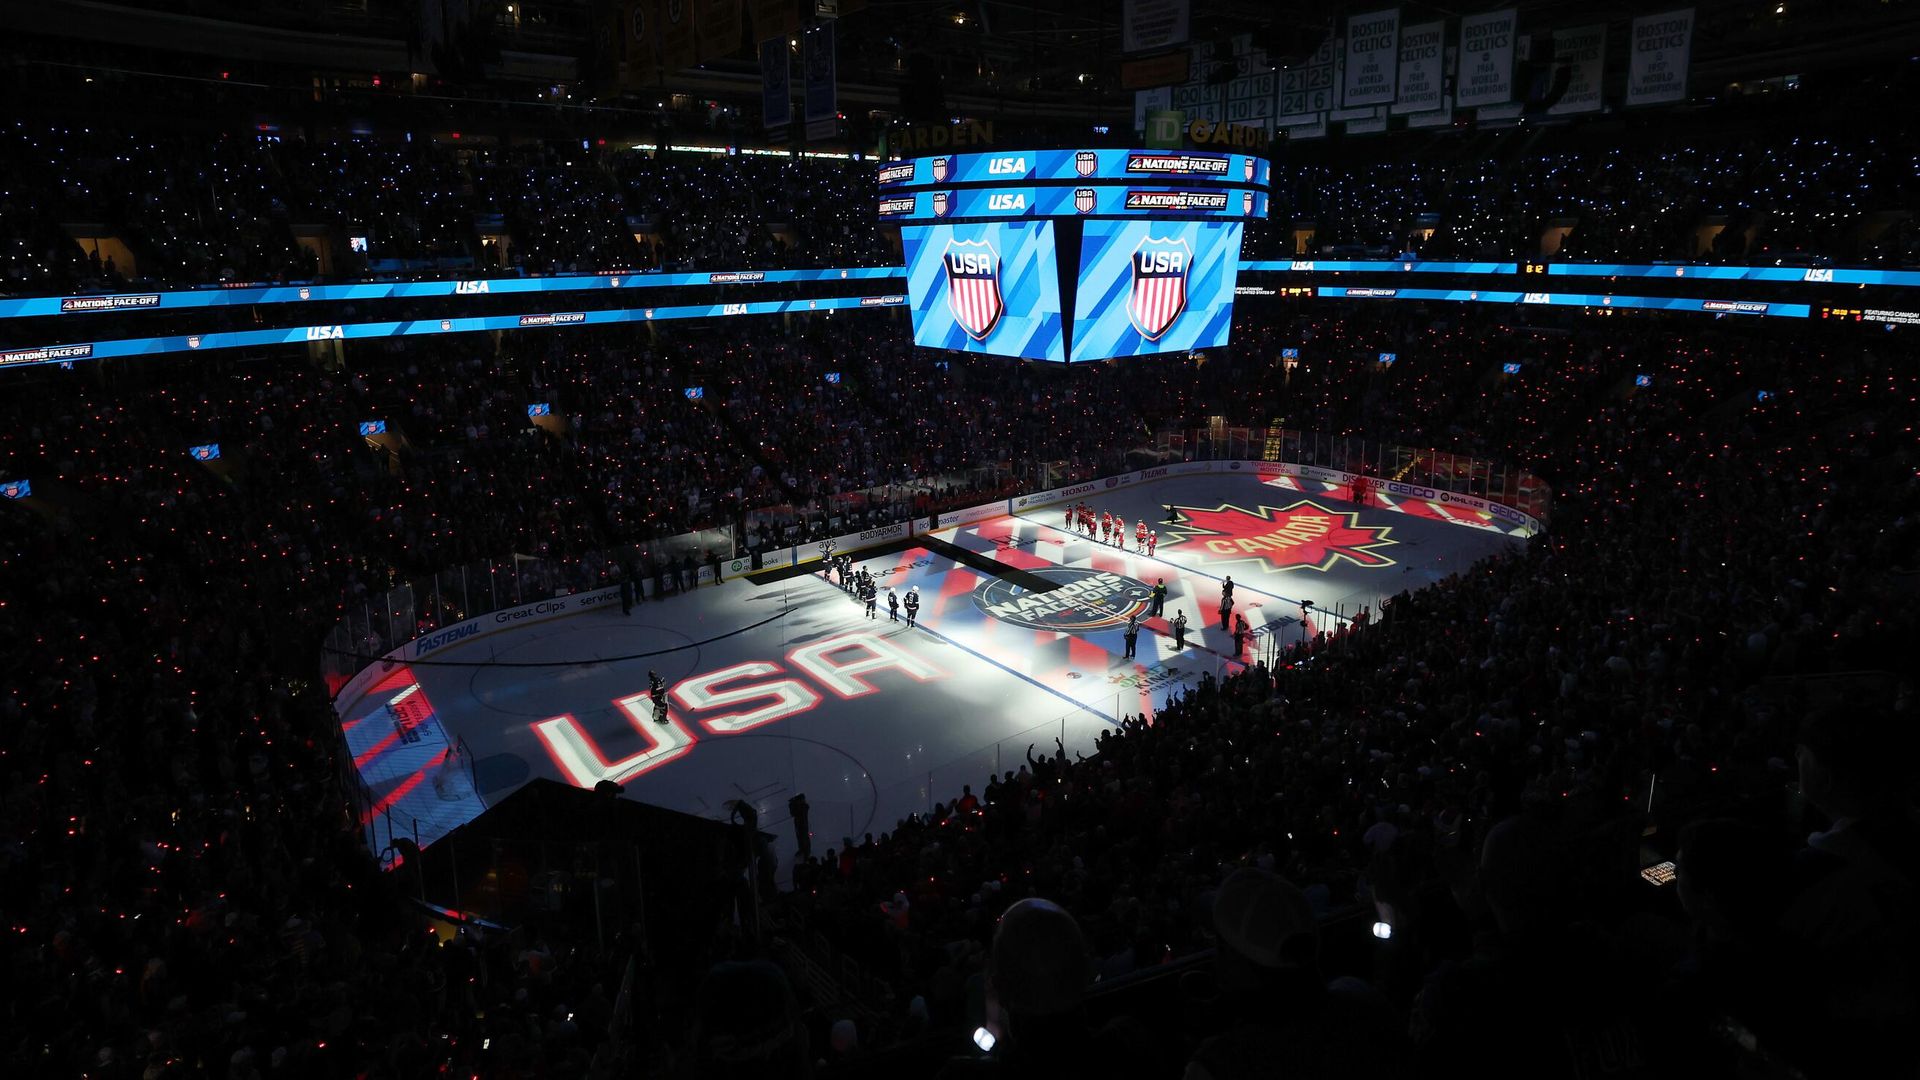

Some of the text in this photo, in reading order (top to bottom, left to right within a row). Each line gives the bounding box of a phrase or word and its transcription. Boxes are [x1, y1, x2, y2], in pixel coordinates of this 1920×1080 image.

[1352, 20, 1394, 38] BOSTON
[1466, 20, 1511, 38] BOSTON
[1637, 19, 1688, 39] BOSTON
[1353, 36, 1392, 53] CELTICS
[1466, 35, 1508, 52] CELTICS
[1638, 34, 1684, 52] CELTICS
[1231, 76, 1271, 97] 17 18
[1286, 68, 1331, 89] 21 25
[1358, 75, 1383, 85] WORLD
[1471, 73, 1499, 86] WORLD
[1349, 85, 1390, 97] CHAMPIONS
[1399, 91, 1438, 103] HAMPIONS
[1460, 84, 1508, 97] CHAMPIONS
[1231, 99, 1266, 118] 10 2
[1284, 92, 1325, 112] 24 6
[901, 121, 993, 151] ARDEN
[1150, 118, 1179, 141] TD
[1078, 153, 1094, 162] USA
[1142, 159, 1188, 171] NATIONS
[989, 158, 1025, 174] USA
[1077, 189, 1093, 198] USA
[1141, 195, 1187, 207] NATIONS
[989, 195, 1025, 210] USA
[951, 252, 992, 275] USA
[1140, 250, 1183, 273] USA
[1290, 261, 1314, 270] USA
[1804, 269, 1833, 281] USA
[455, 281, 490, 294] USA
[74, 298, 114, 309] NATIONS
[1523, 293, 1550, 304] USA
[723, 304, 748, 315] USA
[306, 326, 344, 340] USA
[5, 351, 48, 363] NATIONS
[1140, 467, 1168, 480] TYLENOL
[1342, 474, 1385, 489] DISVER
[1062, 484, 1095, 497] HONDA
[1388, 482, 1435, 499] GEICO
[1488, 503, 1526, 525] GEICO
[919, 515, 959, 530] tickmaster
[860, 524, 902, 541] BODYARMOR
[1205, 515, 1331, 554] CANADA
[870, 560, 934, 578] ISCOVER
[986, 572, 1122, 618] NATIONS
[496, 600, 565, 623] Great Clips
[416, 622, 480, 656] FASTENAL
[530, 631, 955, 791] USA
